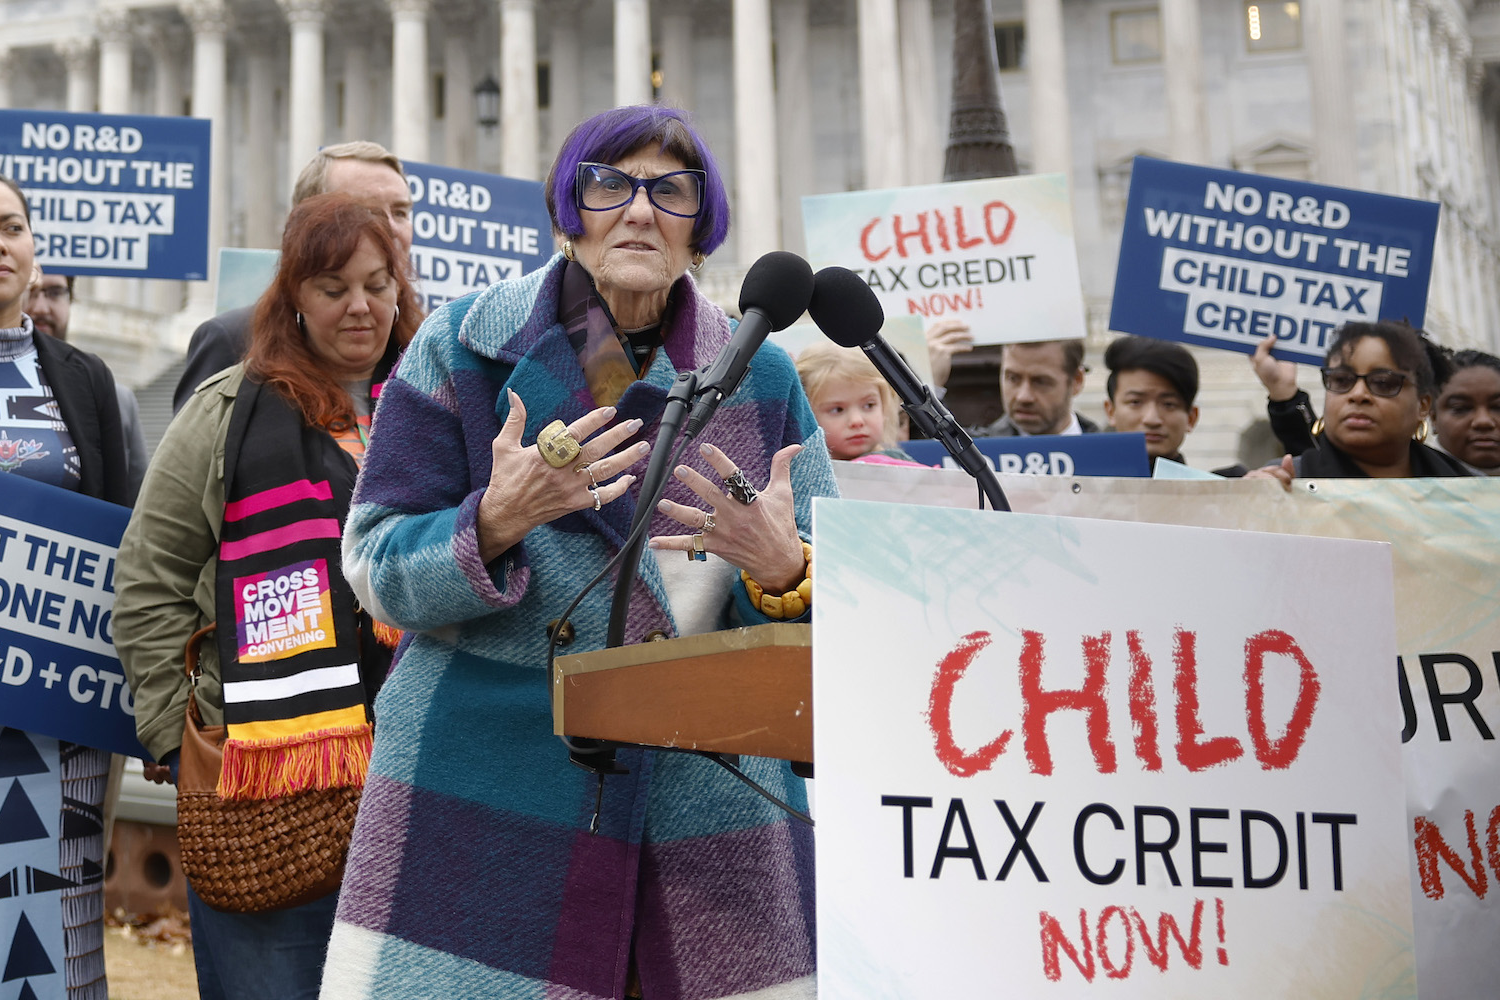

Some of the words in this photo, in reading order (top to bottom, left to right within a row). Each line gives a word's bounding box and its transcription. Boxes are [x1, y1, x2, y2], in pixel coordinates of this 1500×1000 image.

[21, 122, 71, 150] NO
[73, 124, 143, 153] R&D
[130, 161, 194, 190] THE
[28, 197, 96, 223] HILD
[103, 201, 165, 226] TAX
[428, 178, 492, 213] R&D
[1204, 181, 1263, 217] NO
[1266, 190, 1351, 230] R&D
[33, 232, 140, 261] CREDIT
[481, 221, 539, 255] THE
[860, 200, 1017, 263] CHILD
[1144, 207, 1328, 264] WITHOUT
[1333, 238, 1412, 279] THE
[917, 254, 1036, 290] CREDIT
[1173, 259, 1286, 299] CHILD
[1295, 277, 1369, 315] TAX
[906, 287, 984, 318] NOW!
[1196, 302, 1336, 348] CREDIT
[22, 534, 100, 588] THE
[242, 567, 319, 602] CROSS
[243, 586, 322, 623] MOVE
[245, 607, 323, 644] MENT
[247, 629, 326, 656] CONVENING
[38, 662, 63, 690] +
[920, 624, 1320, 778] CHILD
[881, 794, 1050, 882] TAX
[1072, 802, 1358, 891] CREDIT
[1039, 897, 1229, 982] NOW!
